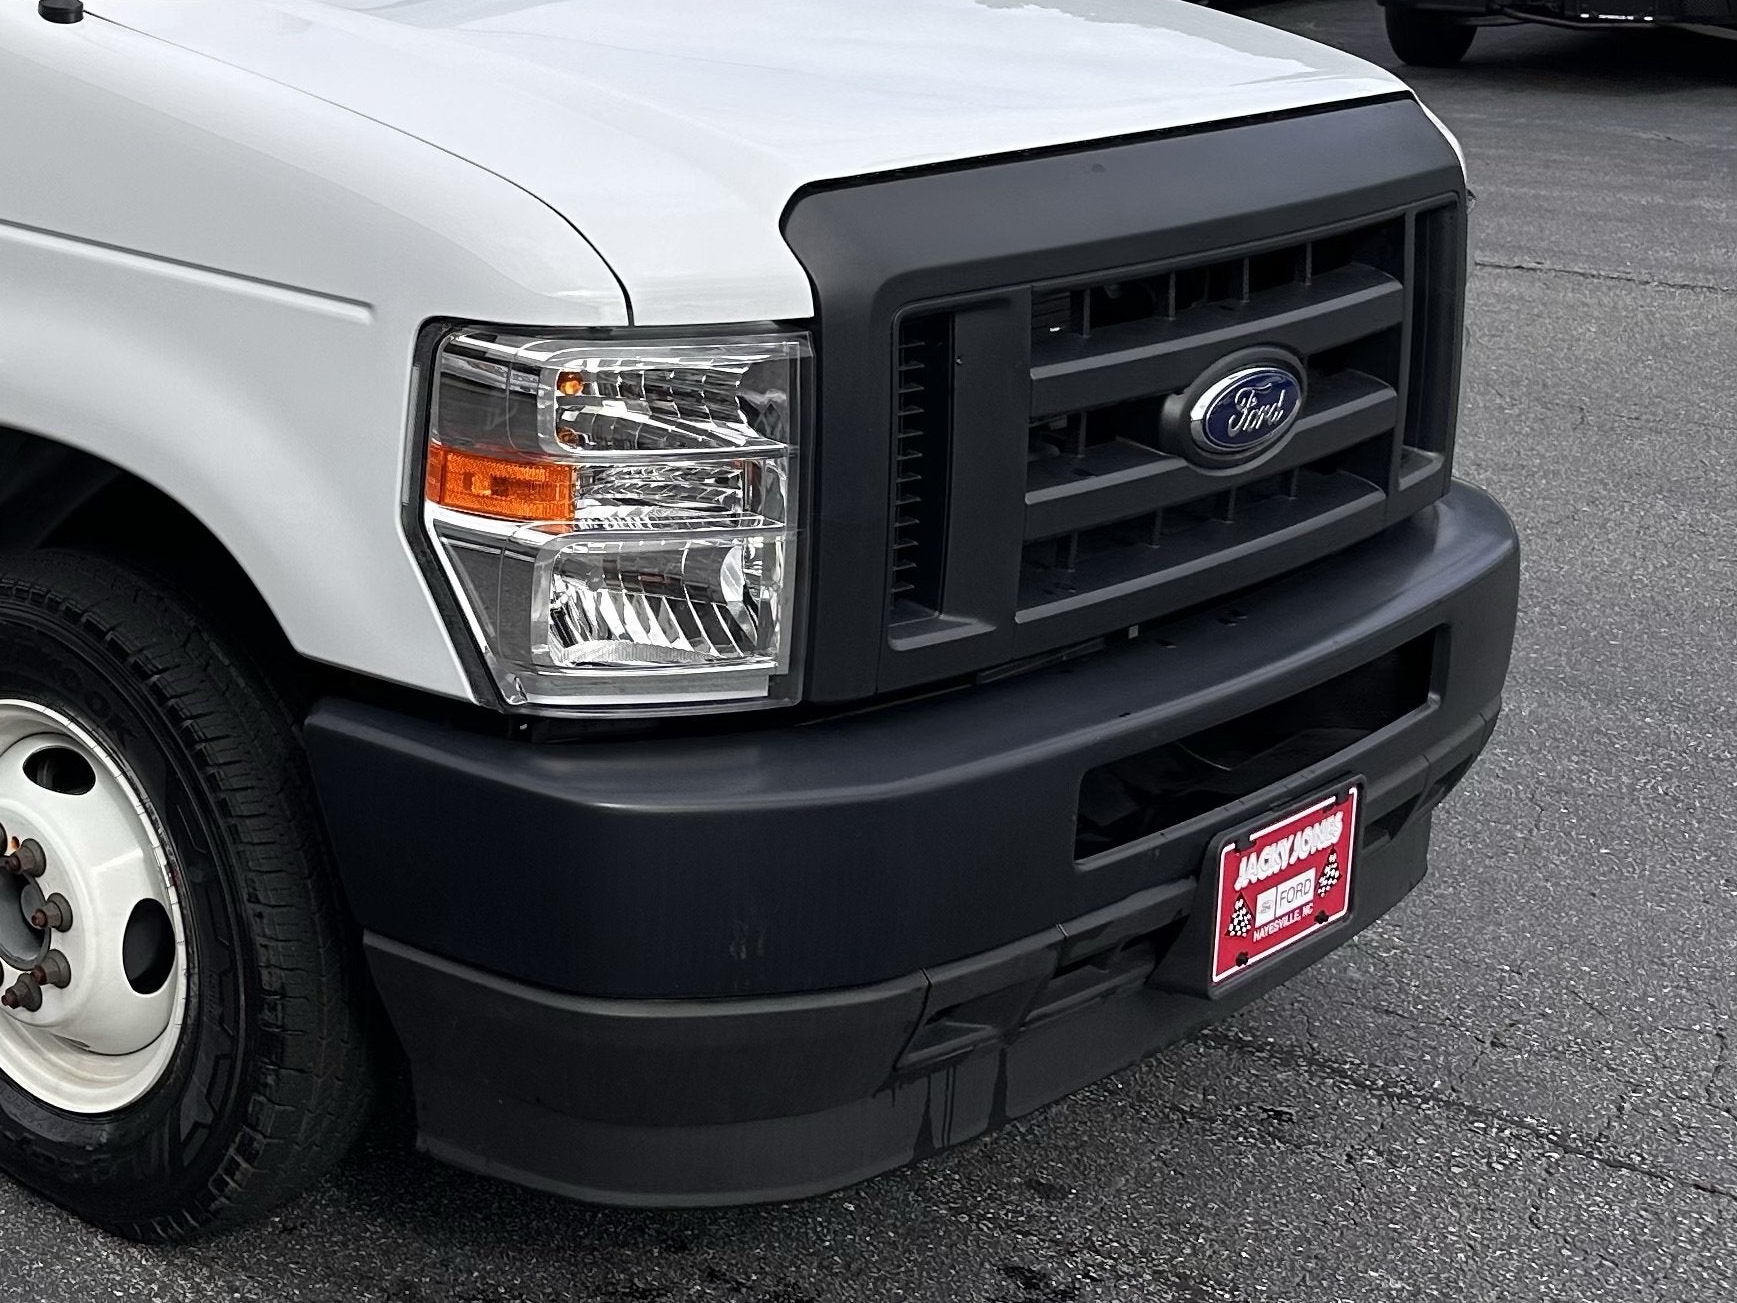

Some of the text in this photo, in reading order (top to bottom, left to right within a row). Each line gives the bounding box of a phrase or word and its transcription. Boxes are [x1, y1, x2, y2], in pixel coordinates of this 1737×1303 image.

[1227, 382, 1286, 437] Ford
[1233, 810, 1344, 891] JACKY JONES
[1279, 878, 1312, 908] FORD
[1301, 902, 1314, 918] NC
